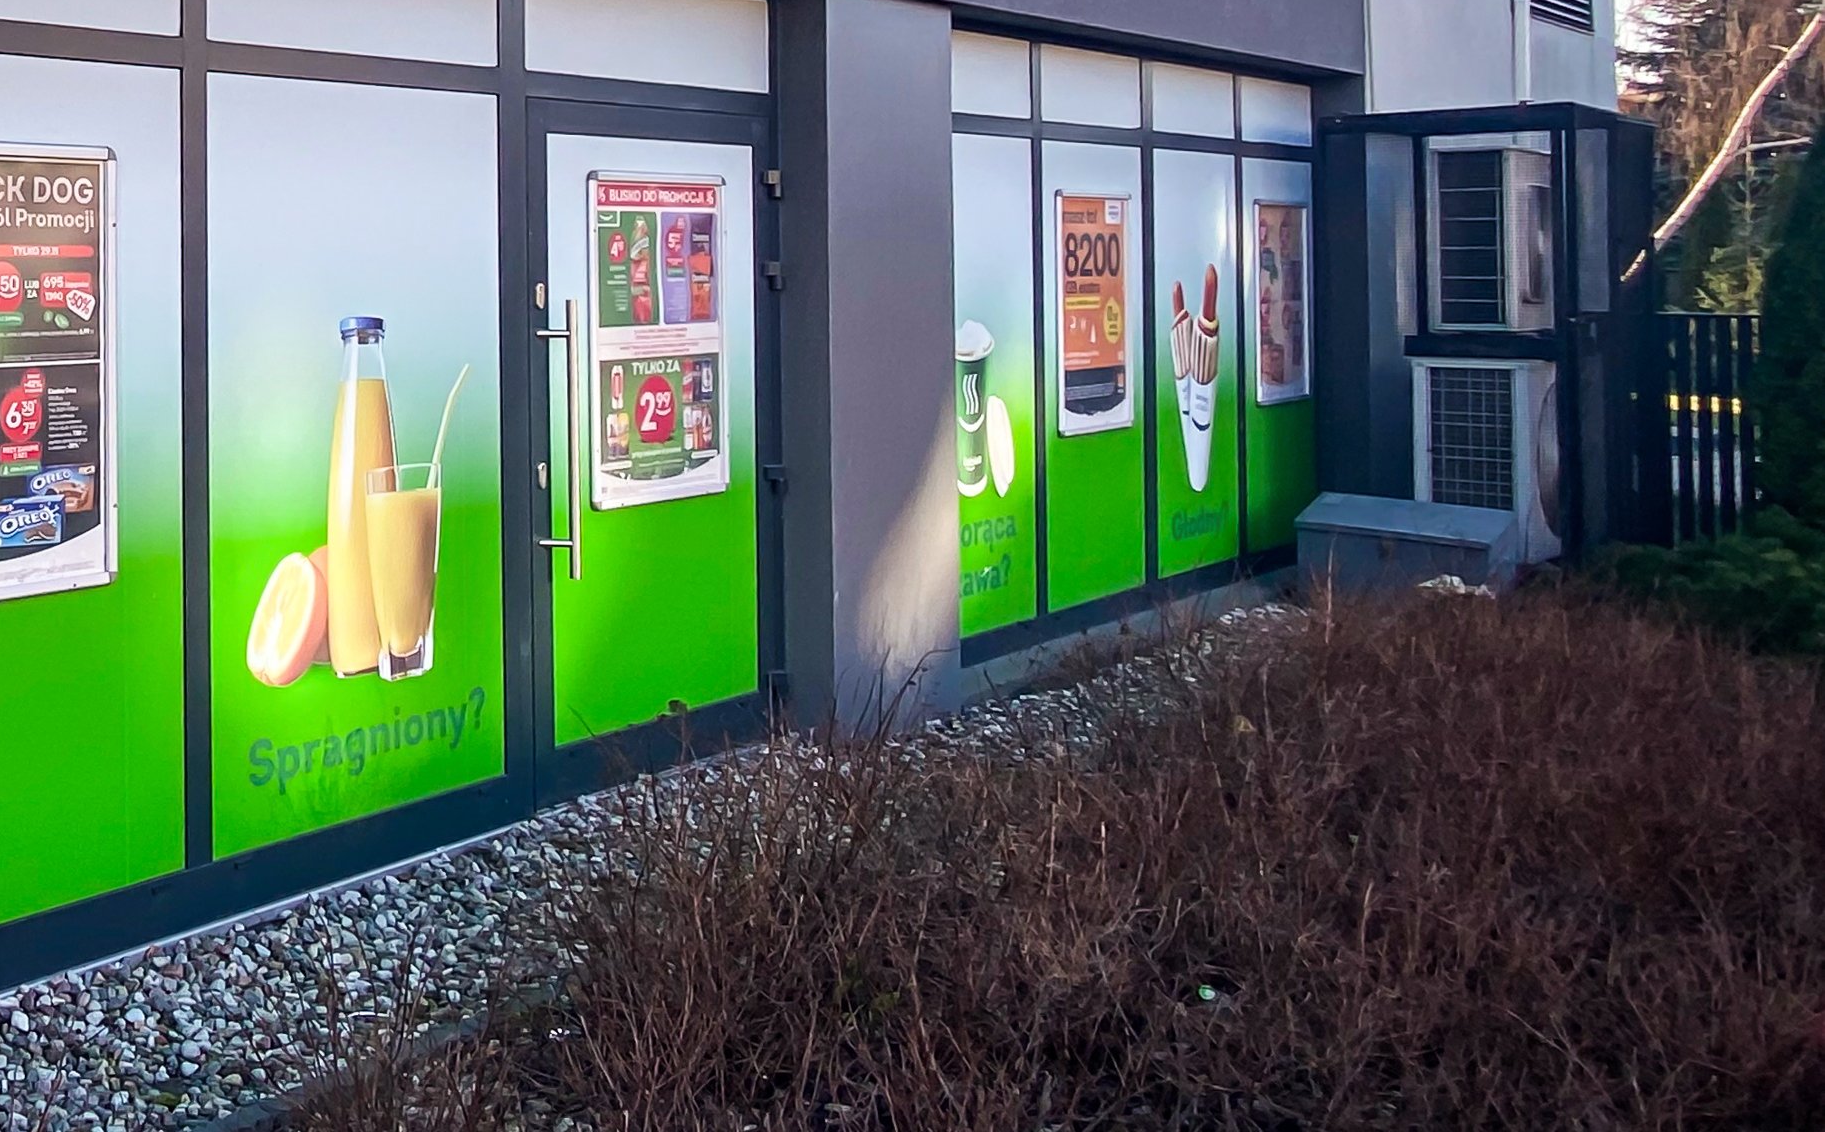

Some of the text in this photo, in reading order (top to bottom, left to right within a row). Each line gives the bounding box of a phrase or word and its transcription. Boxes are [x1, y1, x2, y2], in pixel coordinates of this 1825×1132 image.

[32, 175, 94, 205] DOG
[15, 208, 95, 234] Promocji
[1064, 232, 1120, 277] 8200
[631, 360, 681, 376] TYLKO ZA
[0, 510, 50, 534] OREO
[960, 515, 1016, 553] orąca
[958, 553, 1011, 598] awa?
[248, 686, 487, 795] Spragniony?
